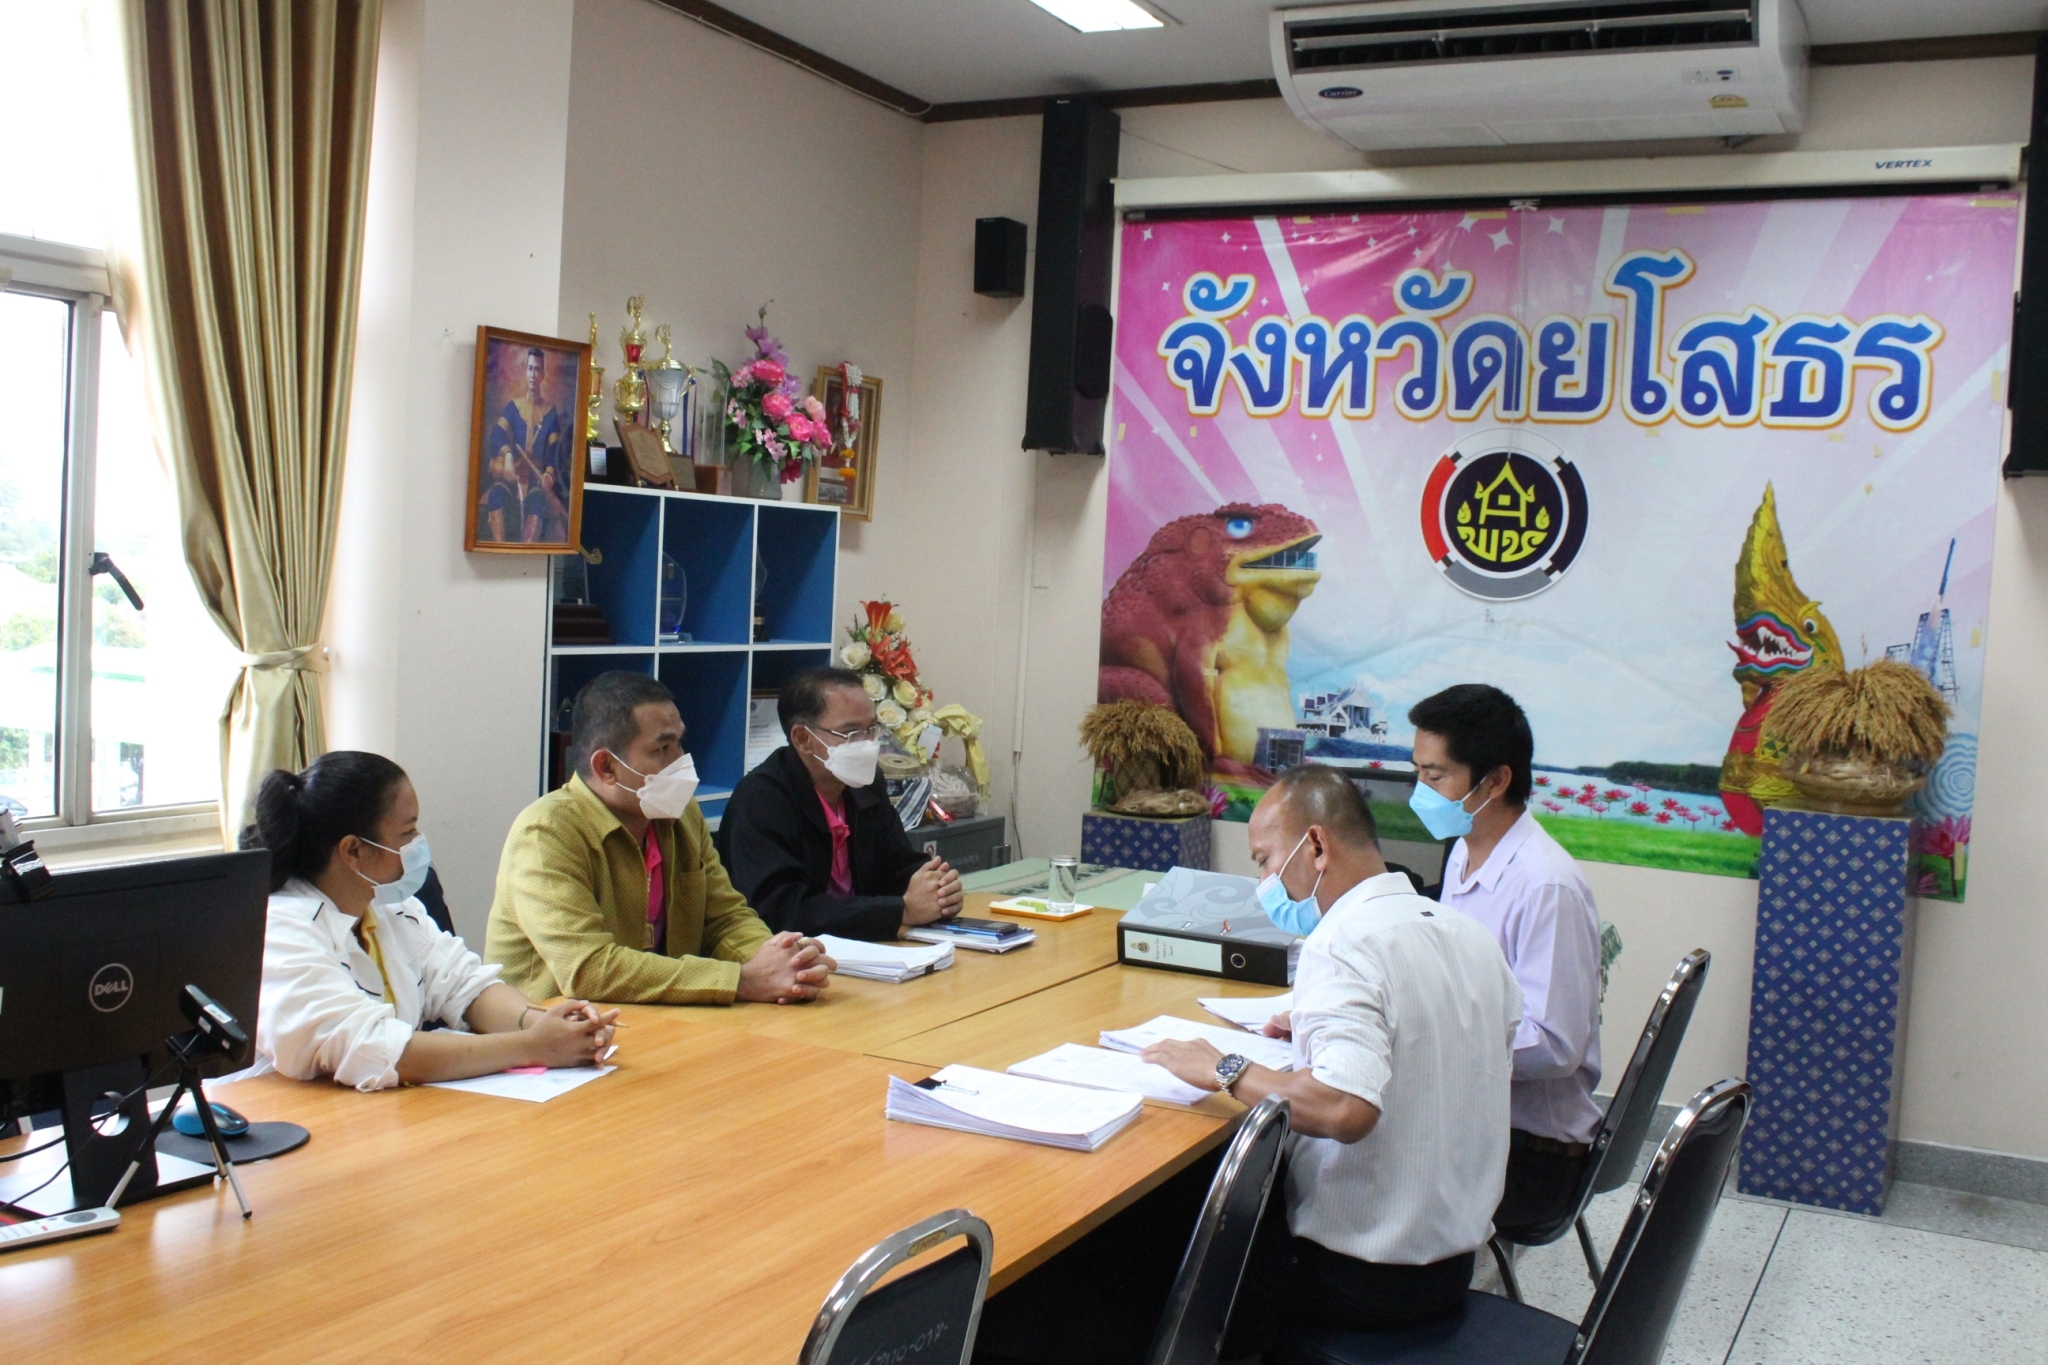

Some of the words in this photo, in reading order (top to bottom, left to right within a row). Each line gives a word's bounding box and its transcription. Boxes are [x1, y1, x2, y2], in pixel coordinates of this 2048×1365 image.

[1323, 89, 1358, 98] Carrier
[1875, 159, 1933, 170] VERTEX
[1159, 248, 1944, 431] จังหวัดยโสธร
[94, 979, 129, 997] DELL
